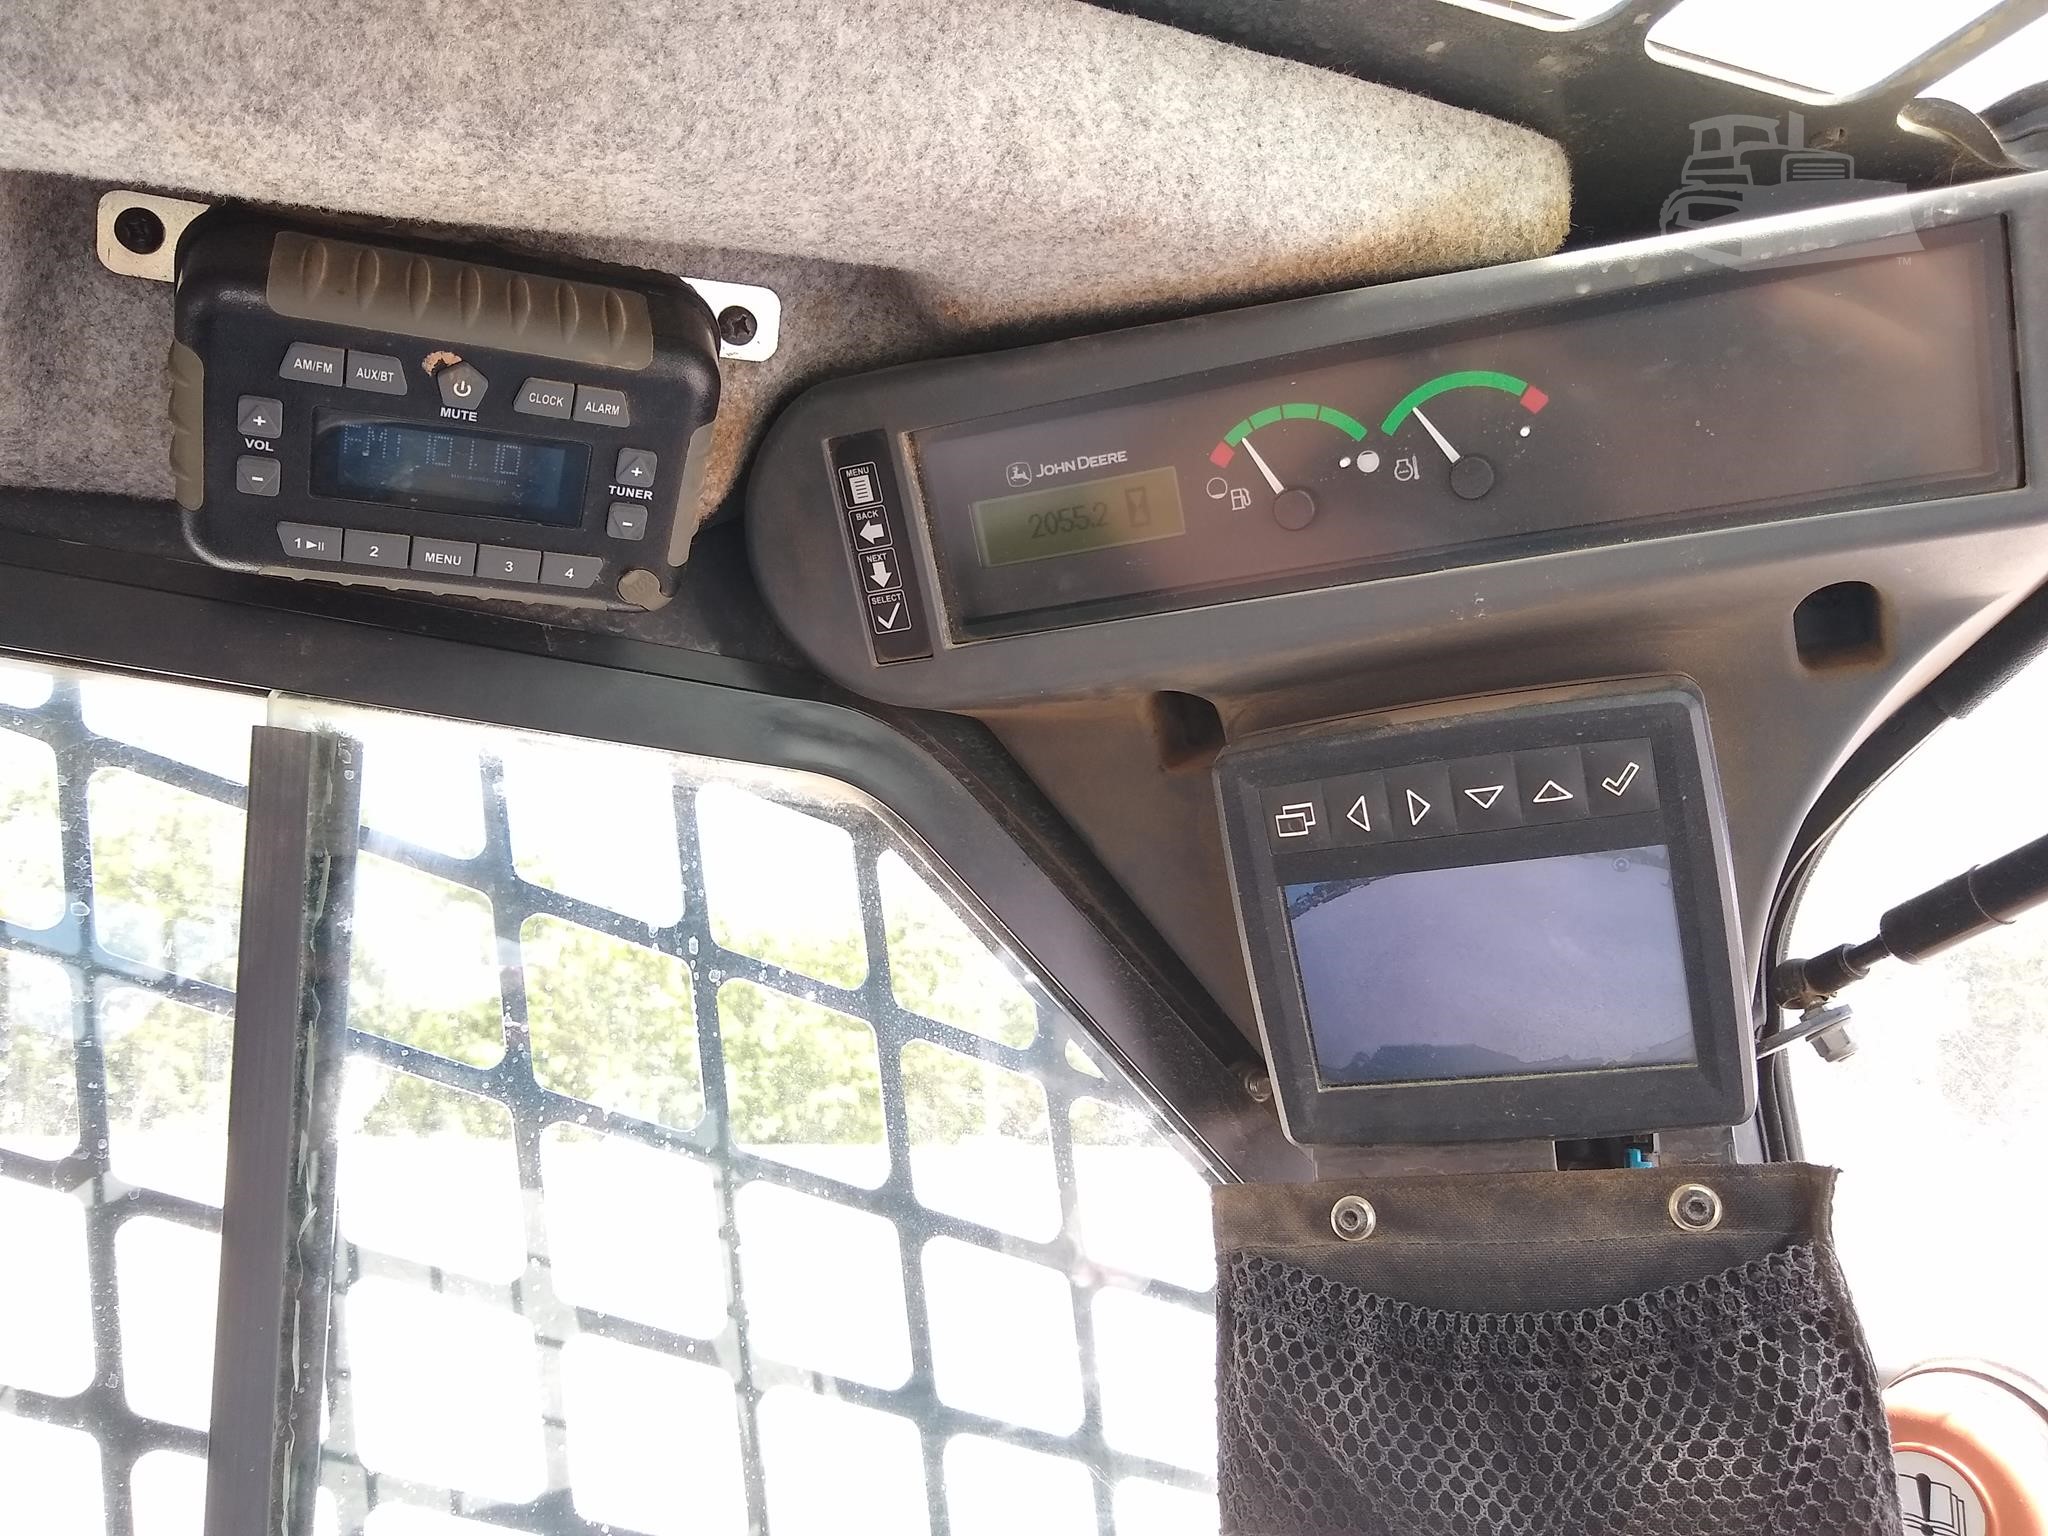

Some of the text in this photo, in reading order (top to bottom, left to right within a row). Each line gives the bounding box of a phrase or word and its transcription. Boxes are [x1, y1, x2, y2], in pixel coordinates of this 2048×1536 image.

[293, 357, 333, 374] AM/FM
[356, 367, 395, 383] AUX/BT
[528, 392, 564, 408] CLOCK
[439, 406, 478, 422] MUTE
[584, 401, 620, 416] ALARM
[244, 437, 274, 452] VOL
[845, 465, 870, 478] MENU
[1035, 450, 1129, 478] JOHN DEERE
[608, 484, 654, 501] TUNER
[855, 509, 880, 522] BACK
[1027, 502, 1109, 539] 2055.2
[293, 537, 301, 550] 1
[369, 545, 380, 558] 2
[424, 551, 462, 567] MENU
[866, 552, 888, 564] NEXT
[504, 560, 514, 573] 3
[564, 567, 575, 580] 4
[871, 592, 902, 606] SELECT
